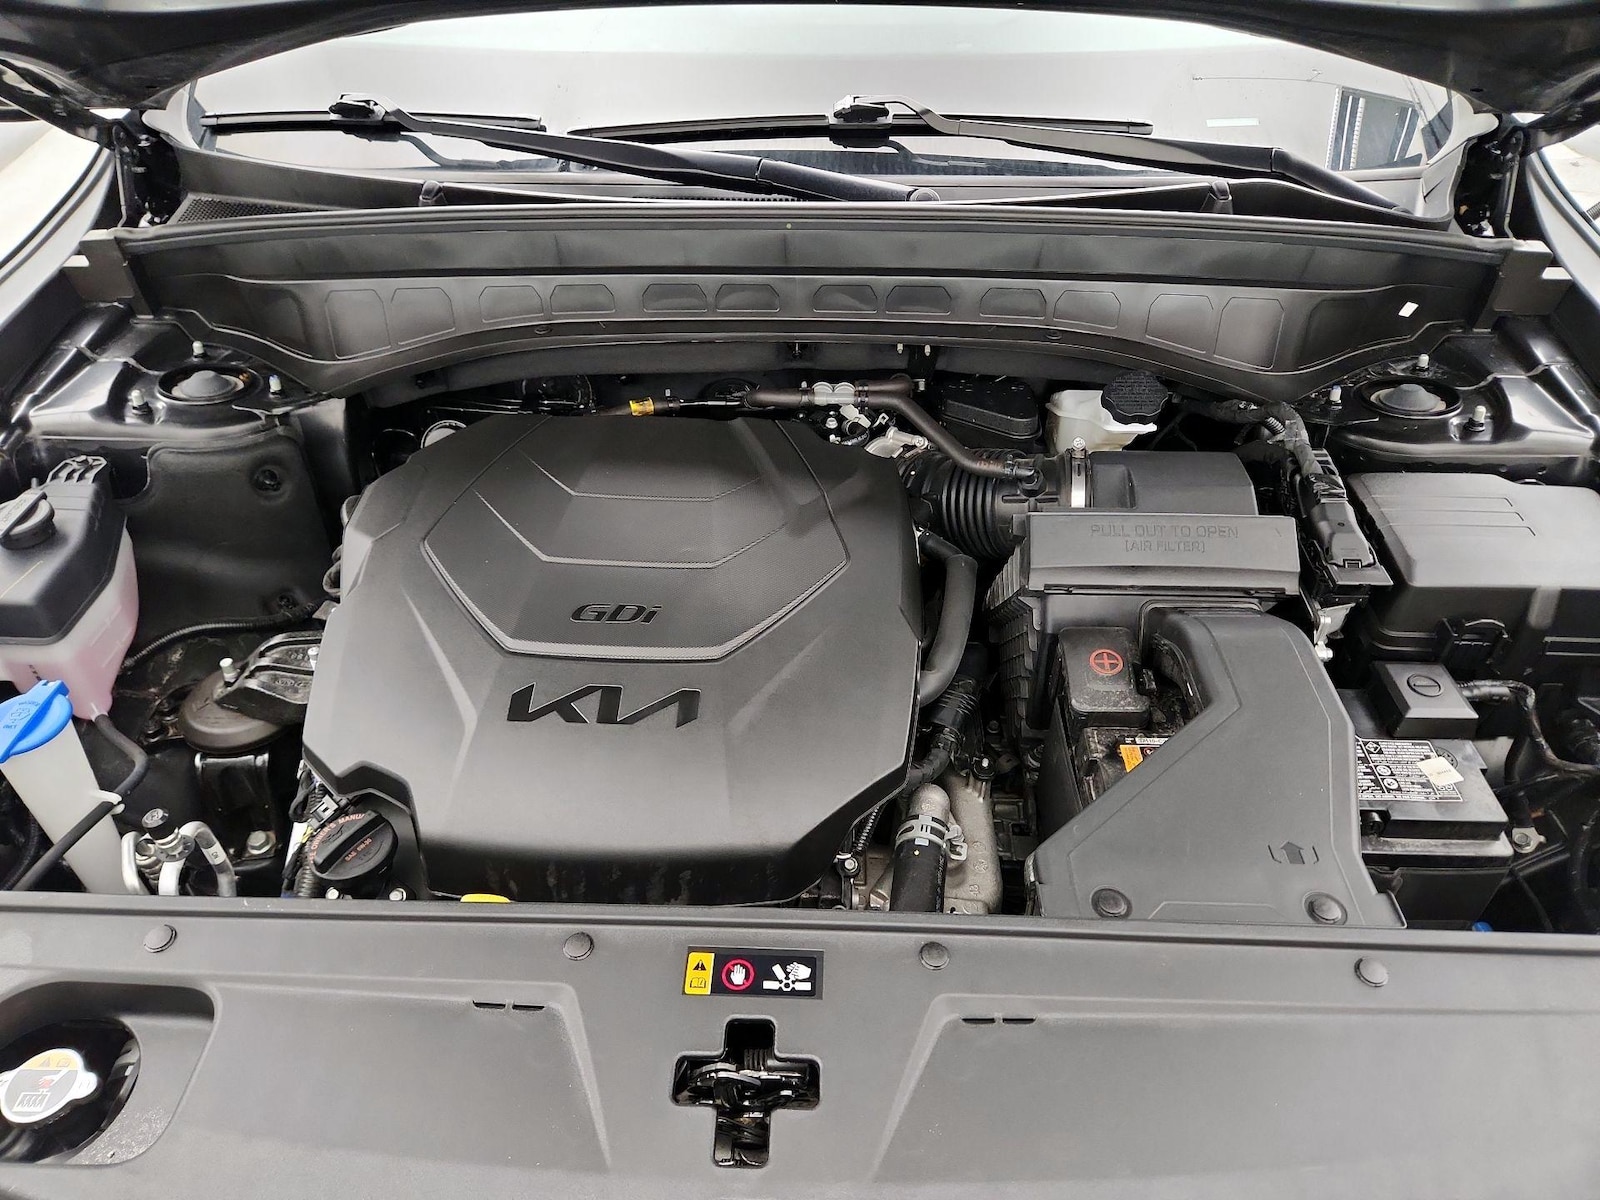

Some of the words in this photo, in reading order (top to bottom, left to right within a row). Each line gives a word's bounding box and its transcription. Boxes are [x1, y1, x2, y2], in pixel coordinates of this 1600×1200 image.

[1091, 524, 1130, 537] PULL
[1135, 524, 1166, 537] OUT
[1173, 525, 1191, 538] TO
[1196, 525, 1239, 539] OPEN
[569, 603, 663, 625] GDi
[507, 682, 702, 729] KIA
[338, 813, 366, 824] MANU
[345, 850, 357, 861] SAE
